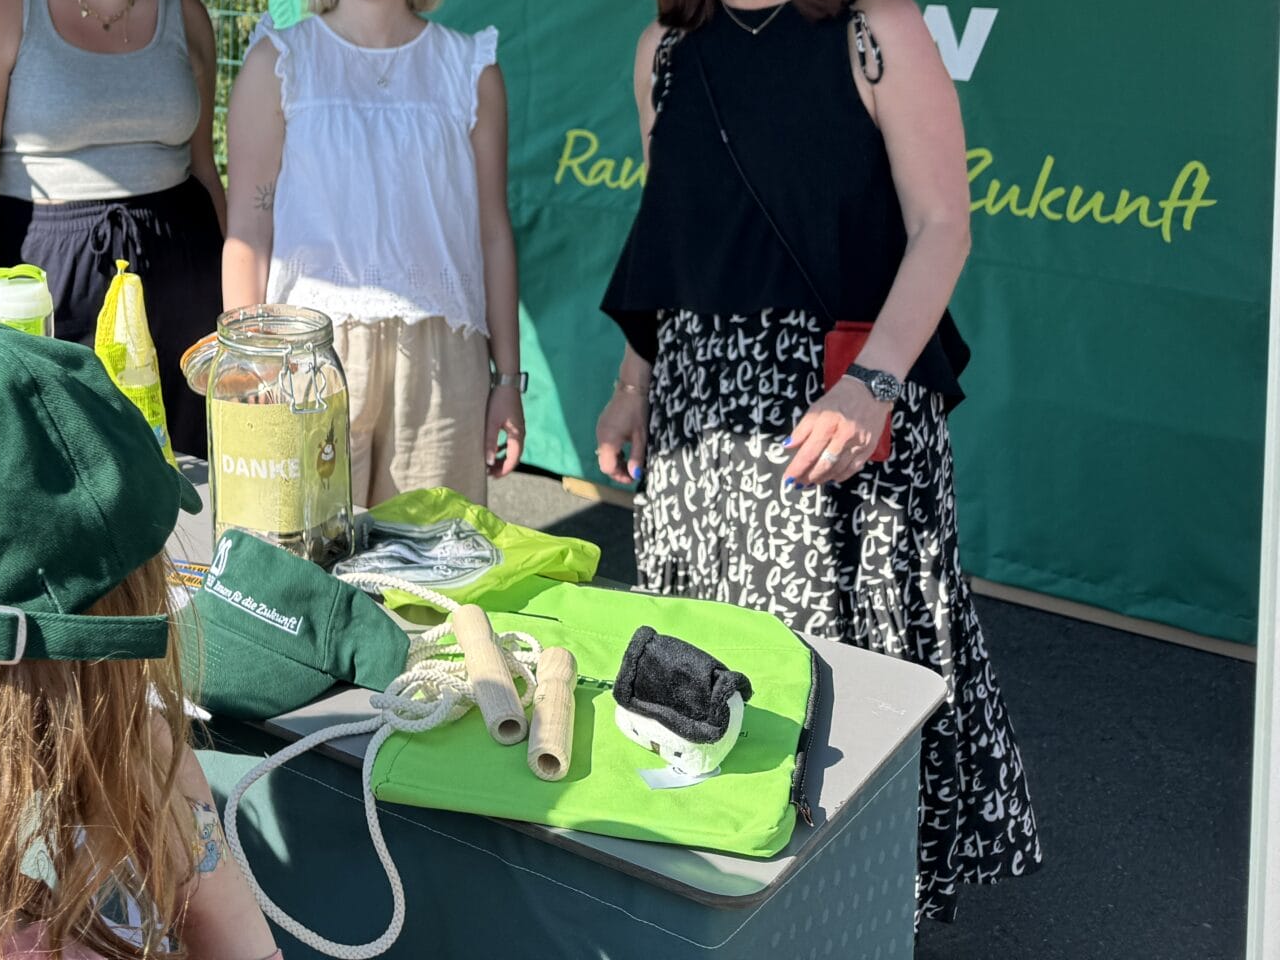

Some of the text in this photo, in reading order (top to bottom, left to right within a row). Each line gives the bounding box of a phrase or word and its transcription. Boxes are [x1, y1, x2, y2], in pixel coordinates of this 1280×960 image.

[554, 129, 1218, 242] Rau Zukunft
[222, 454, 301, 480] DANKE
[255, 603, 298, 630] Zukunft
